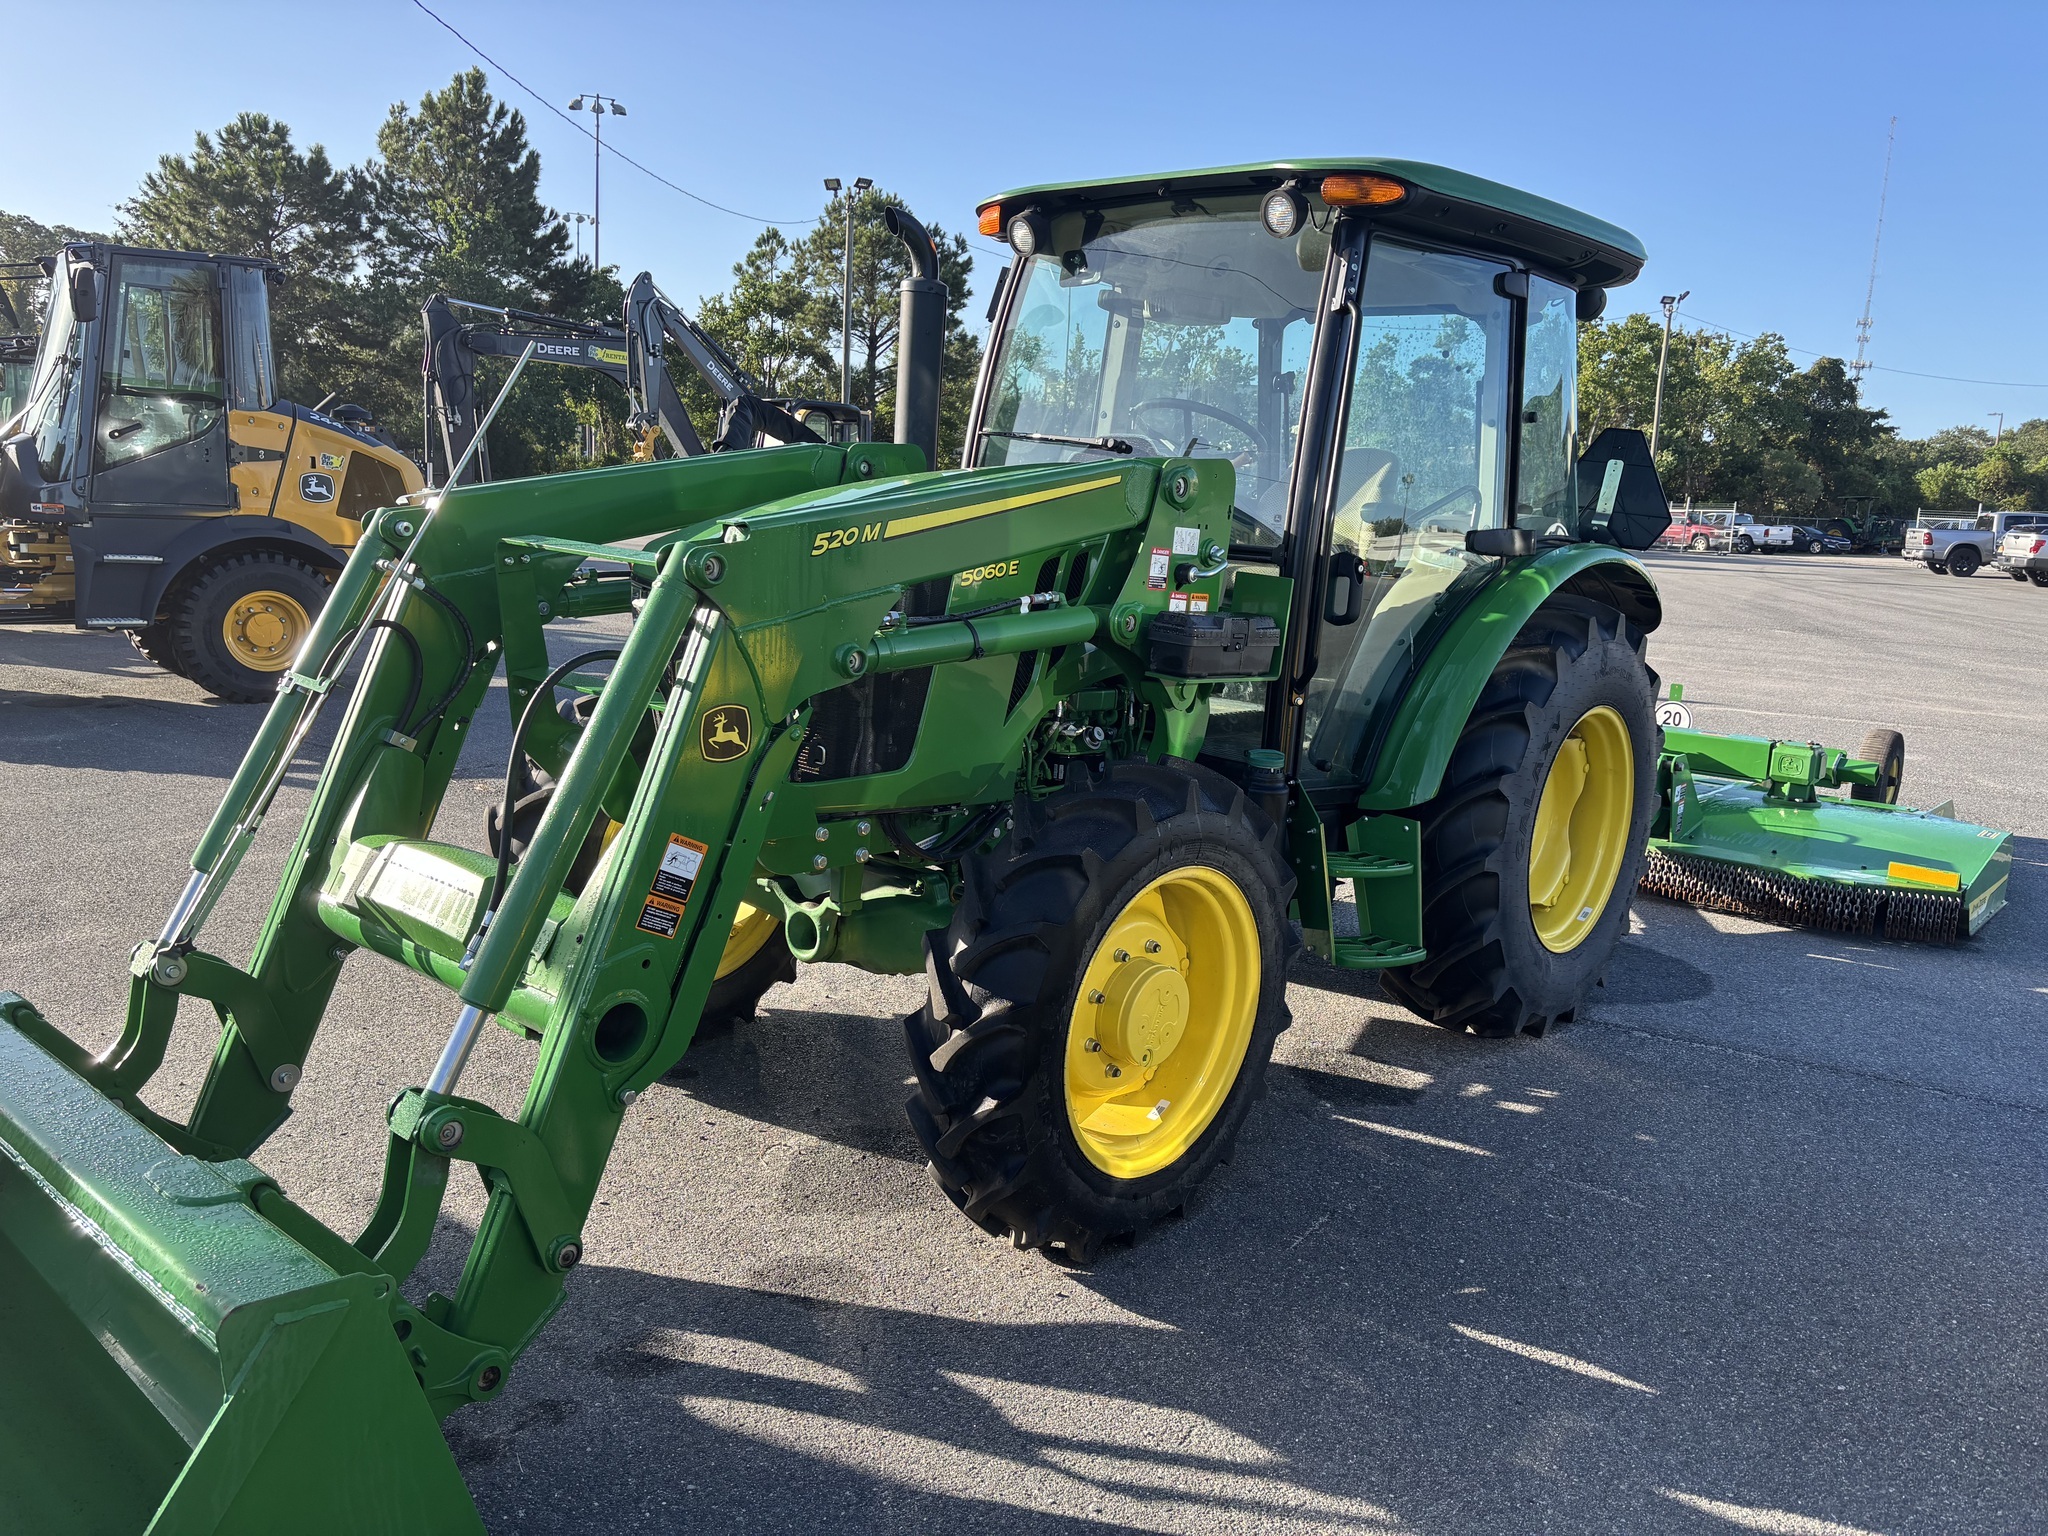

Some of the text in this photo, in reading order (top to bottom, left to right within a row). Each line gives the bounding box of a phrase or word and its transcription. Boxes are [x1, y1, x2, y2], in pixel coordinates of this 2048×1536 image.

[537, 342, 580, 356] DEERE
[706, 360, 734, 392] DEERE
[309, 412, 344, 429] 244
[811, 522, 882, 556] 520 M
[960, 560, 1020, 587] 5060 E
[1662, 711, 1682, 727] 20
[679, 839, 703, 851] WARNING
[656, 901, 680, 912] WARNING
